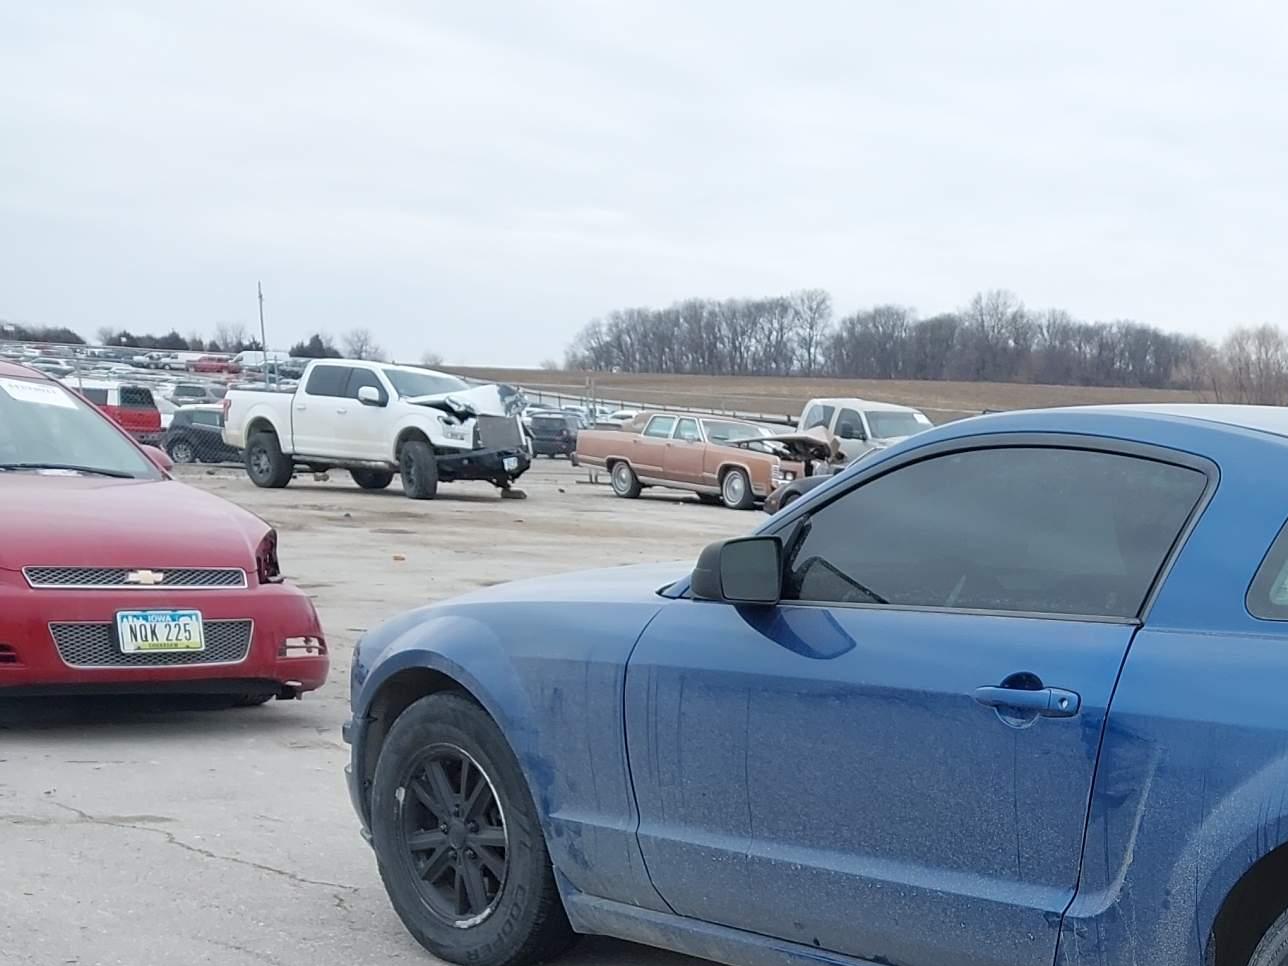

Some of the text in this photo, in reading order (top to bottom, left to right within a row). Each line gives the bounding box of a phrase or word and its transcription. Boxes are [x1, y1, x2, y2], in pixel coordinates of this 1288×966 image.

[147, 614, 172, 623] IOWA
[129, 622, 192, 642] NQK 225
